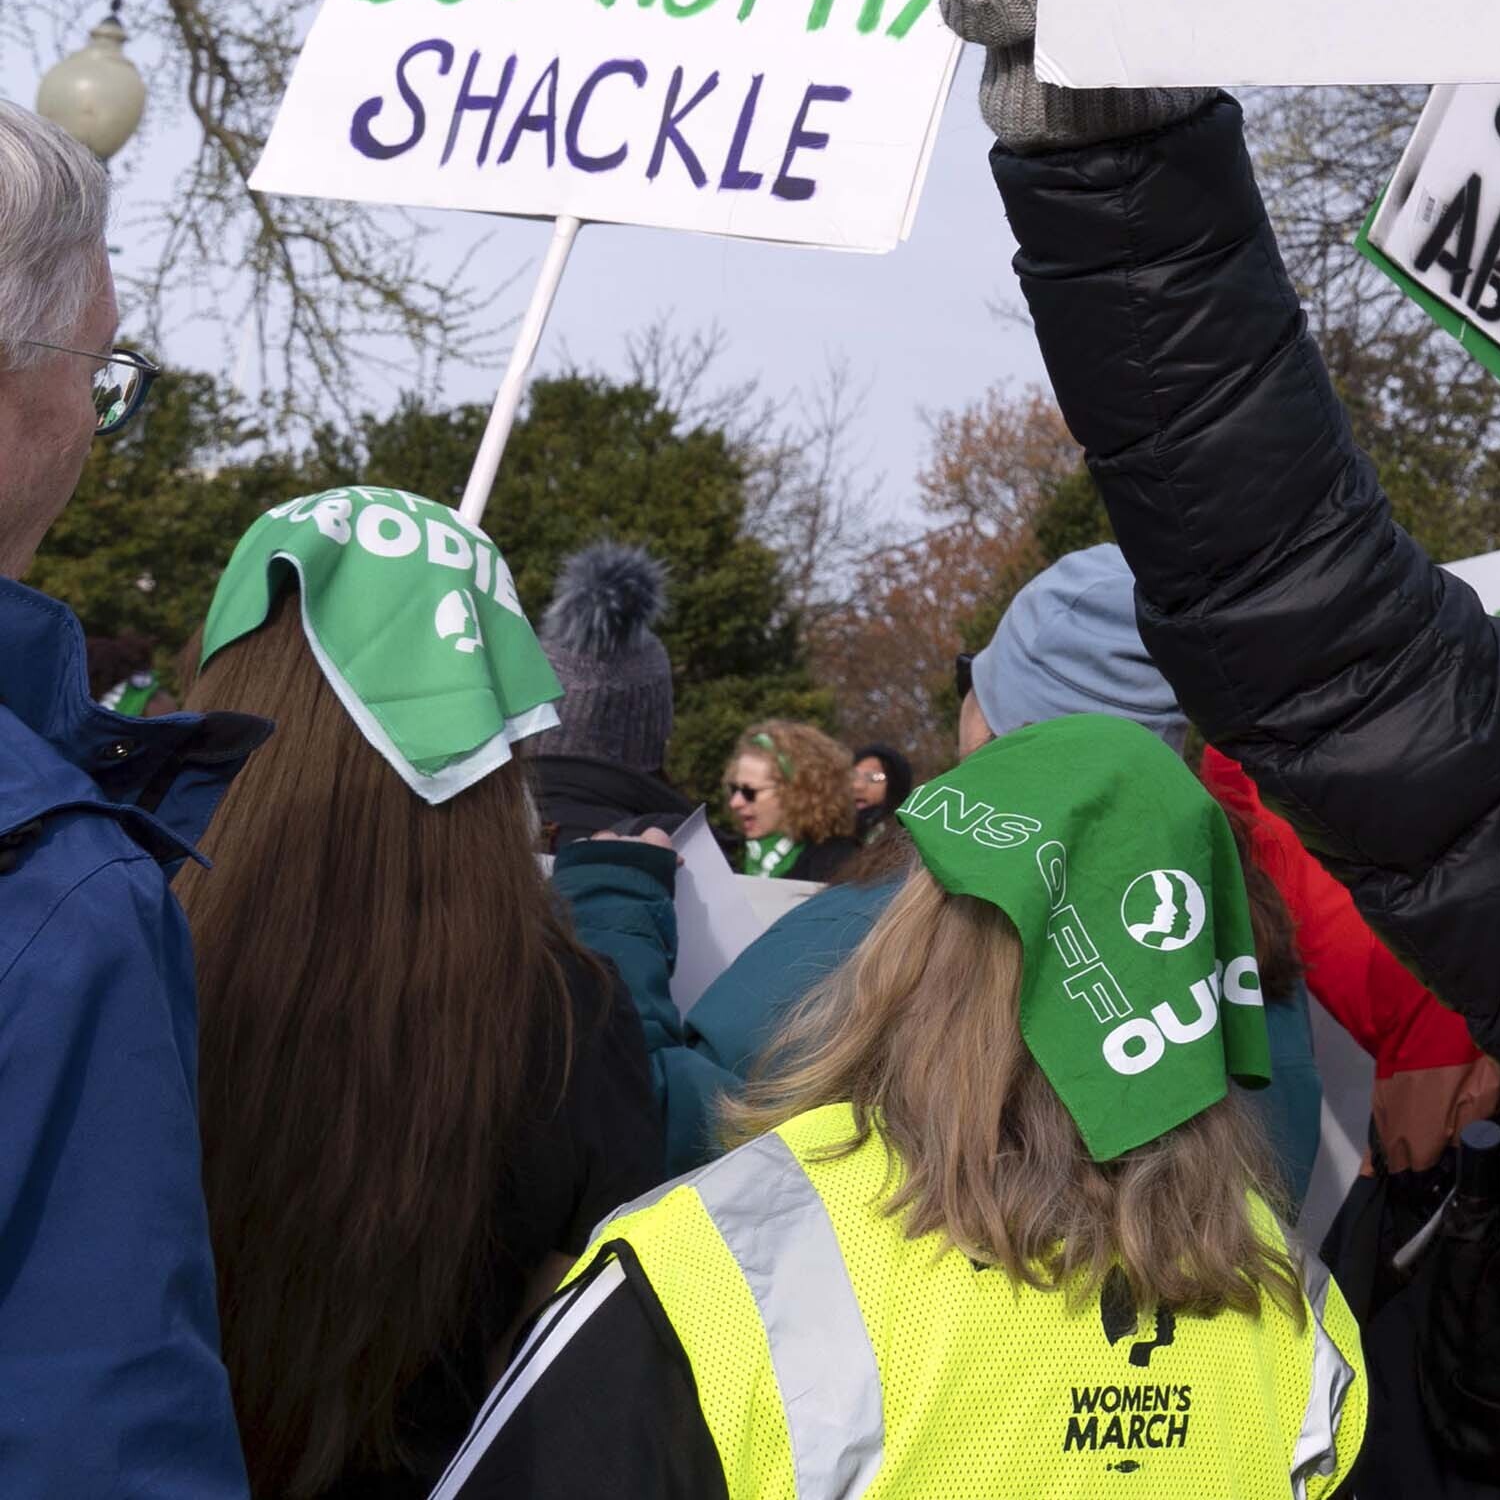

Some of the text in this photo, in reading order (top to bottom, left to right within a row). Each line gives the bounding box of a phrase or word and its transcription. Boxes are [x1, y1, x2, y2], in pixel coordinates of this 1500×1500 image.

[349, 37, 853, 203] SHACKLE
[1102, 970, 1220, 1076] OU
[1062, 1414, 1190, 1454] MARCH
[1070, 1384, 1192, 1414] WOMEN'S
